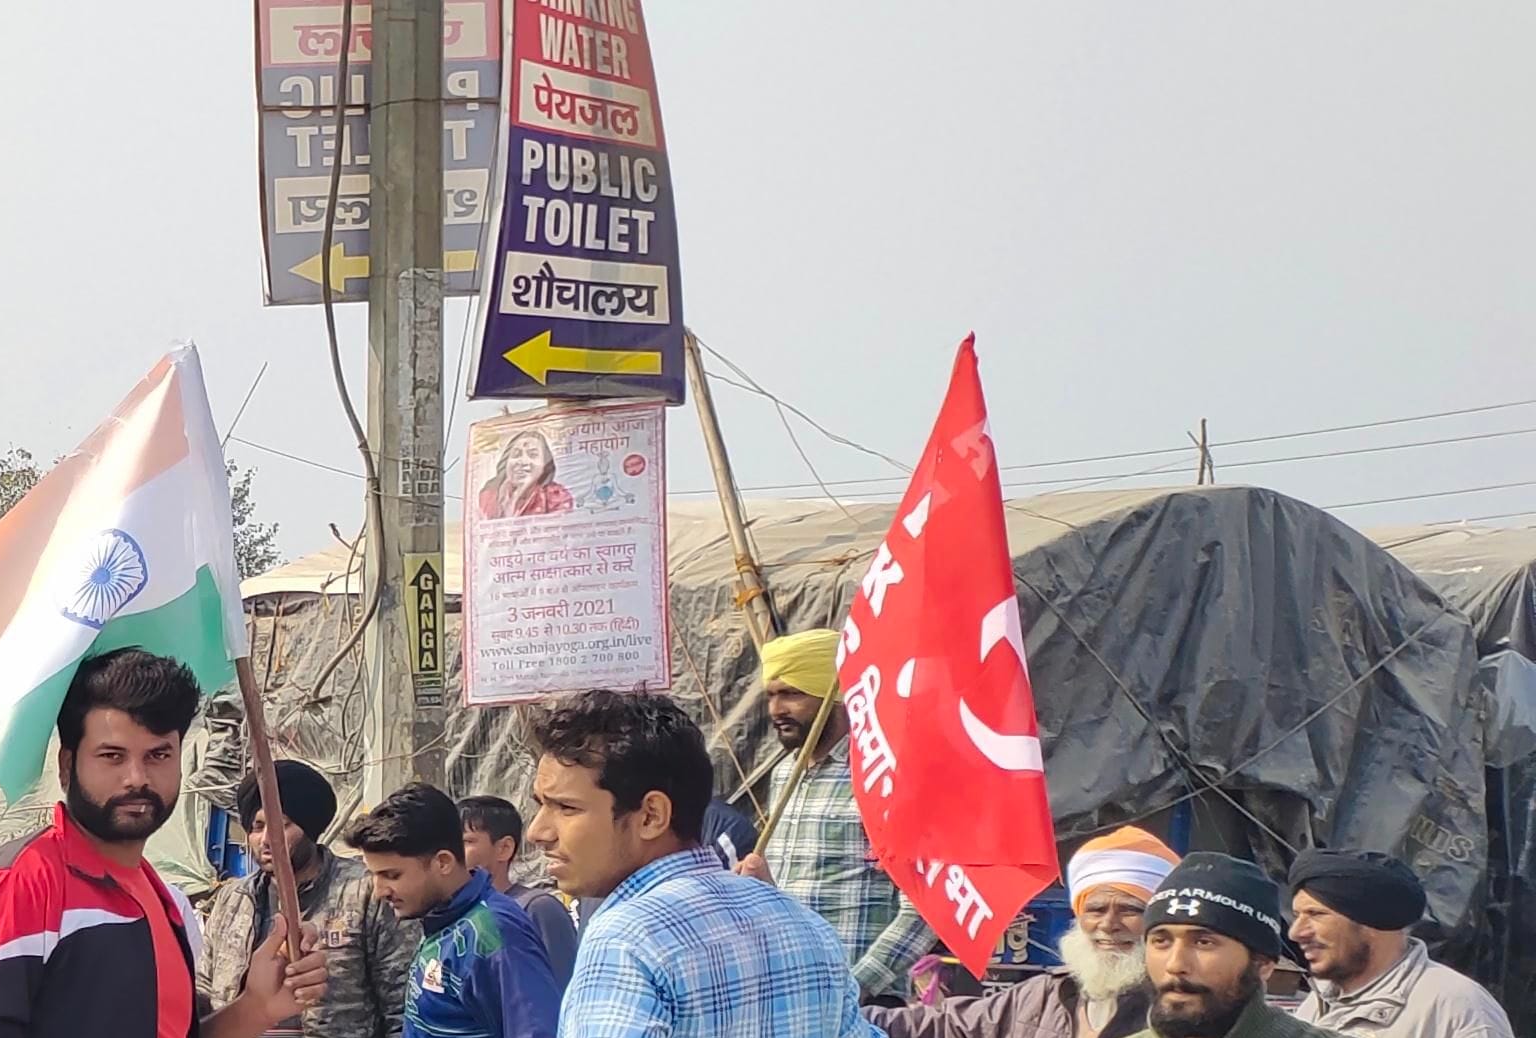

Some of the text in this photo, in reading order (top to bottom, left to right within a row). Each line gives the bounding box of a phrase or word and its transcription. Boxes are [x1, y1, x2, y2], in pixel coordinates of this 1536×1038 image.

[539, 12, 630, 79] WATER
[533, 72, 640, 136] पेयजल
[521, 139, 658, 203] PUBLIC
[523, 195, 655, 255] TOILET
[512, 261, 659, 317] शौचालय
[419, 574, 436, 669] GANGA
[508, 598, 615, 623] 3 जनवरी 2021
[480, 634, 652, 659] www.sahajayoga.org.in/live
[1178, 888, 1254, 917] ARMOUR
